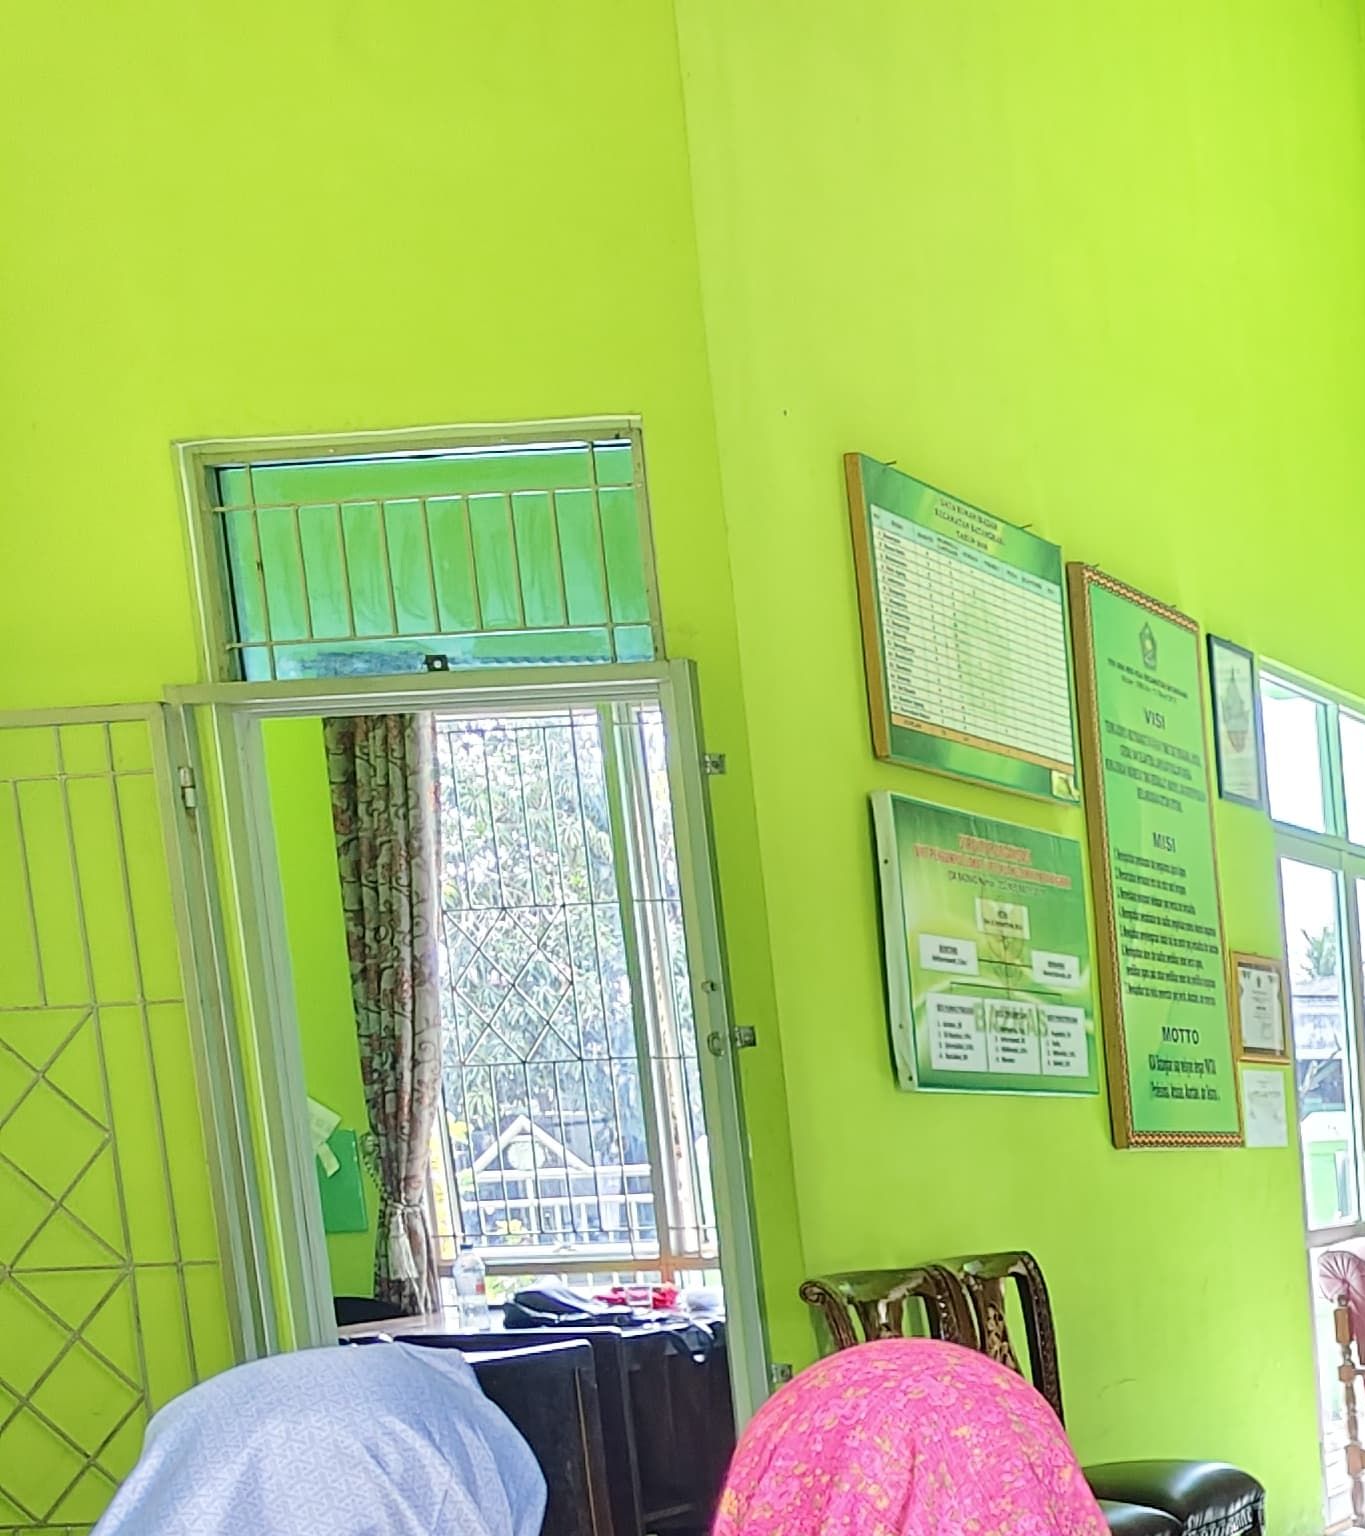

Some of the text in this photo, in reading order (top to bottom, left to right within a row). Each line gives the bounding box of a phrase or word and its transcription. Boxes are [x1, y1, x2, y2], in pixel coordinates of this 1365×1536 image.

[1143, 707, 1166, 730] VISI
[1152, 831, 1176, 854] MISI
[1161, 1026, 1200, 1045] MOTTO
